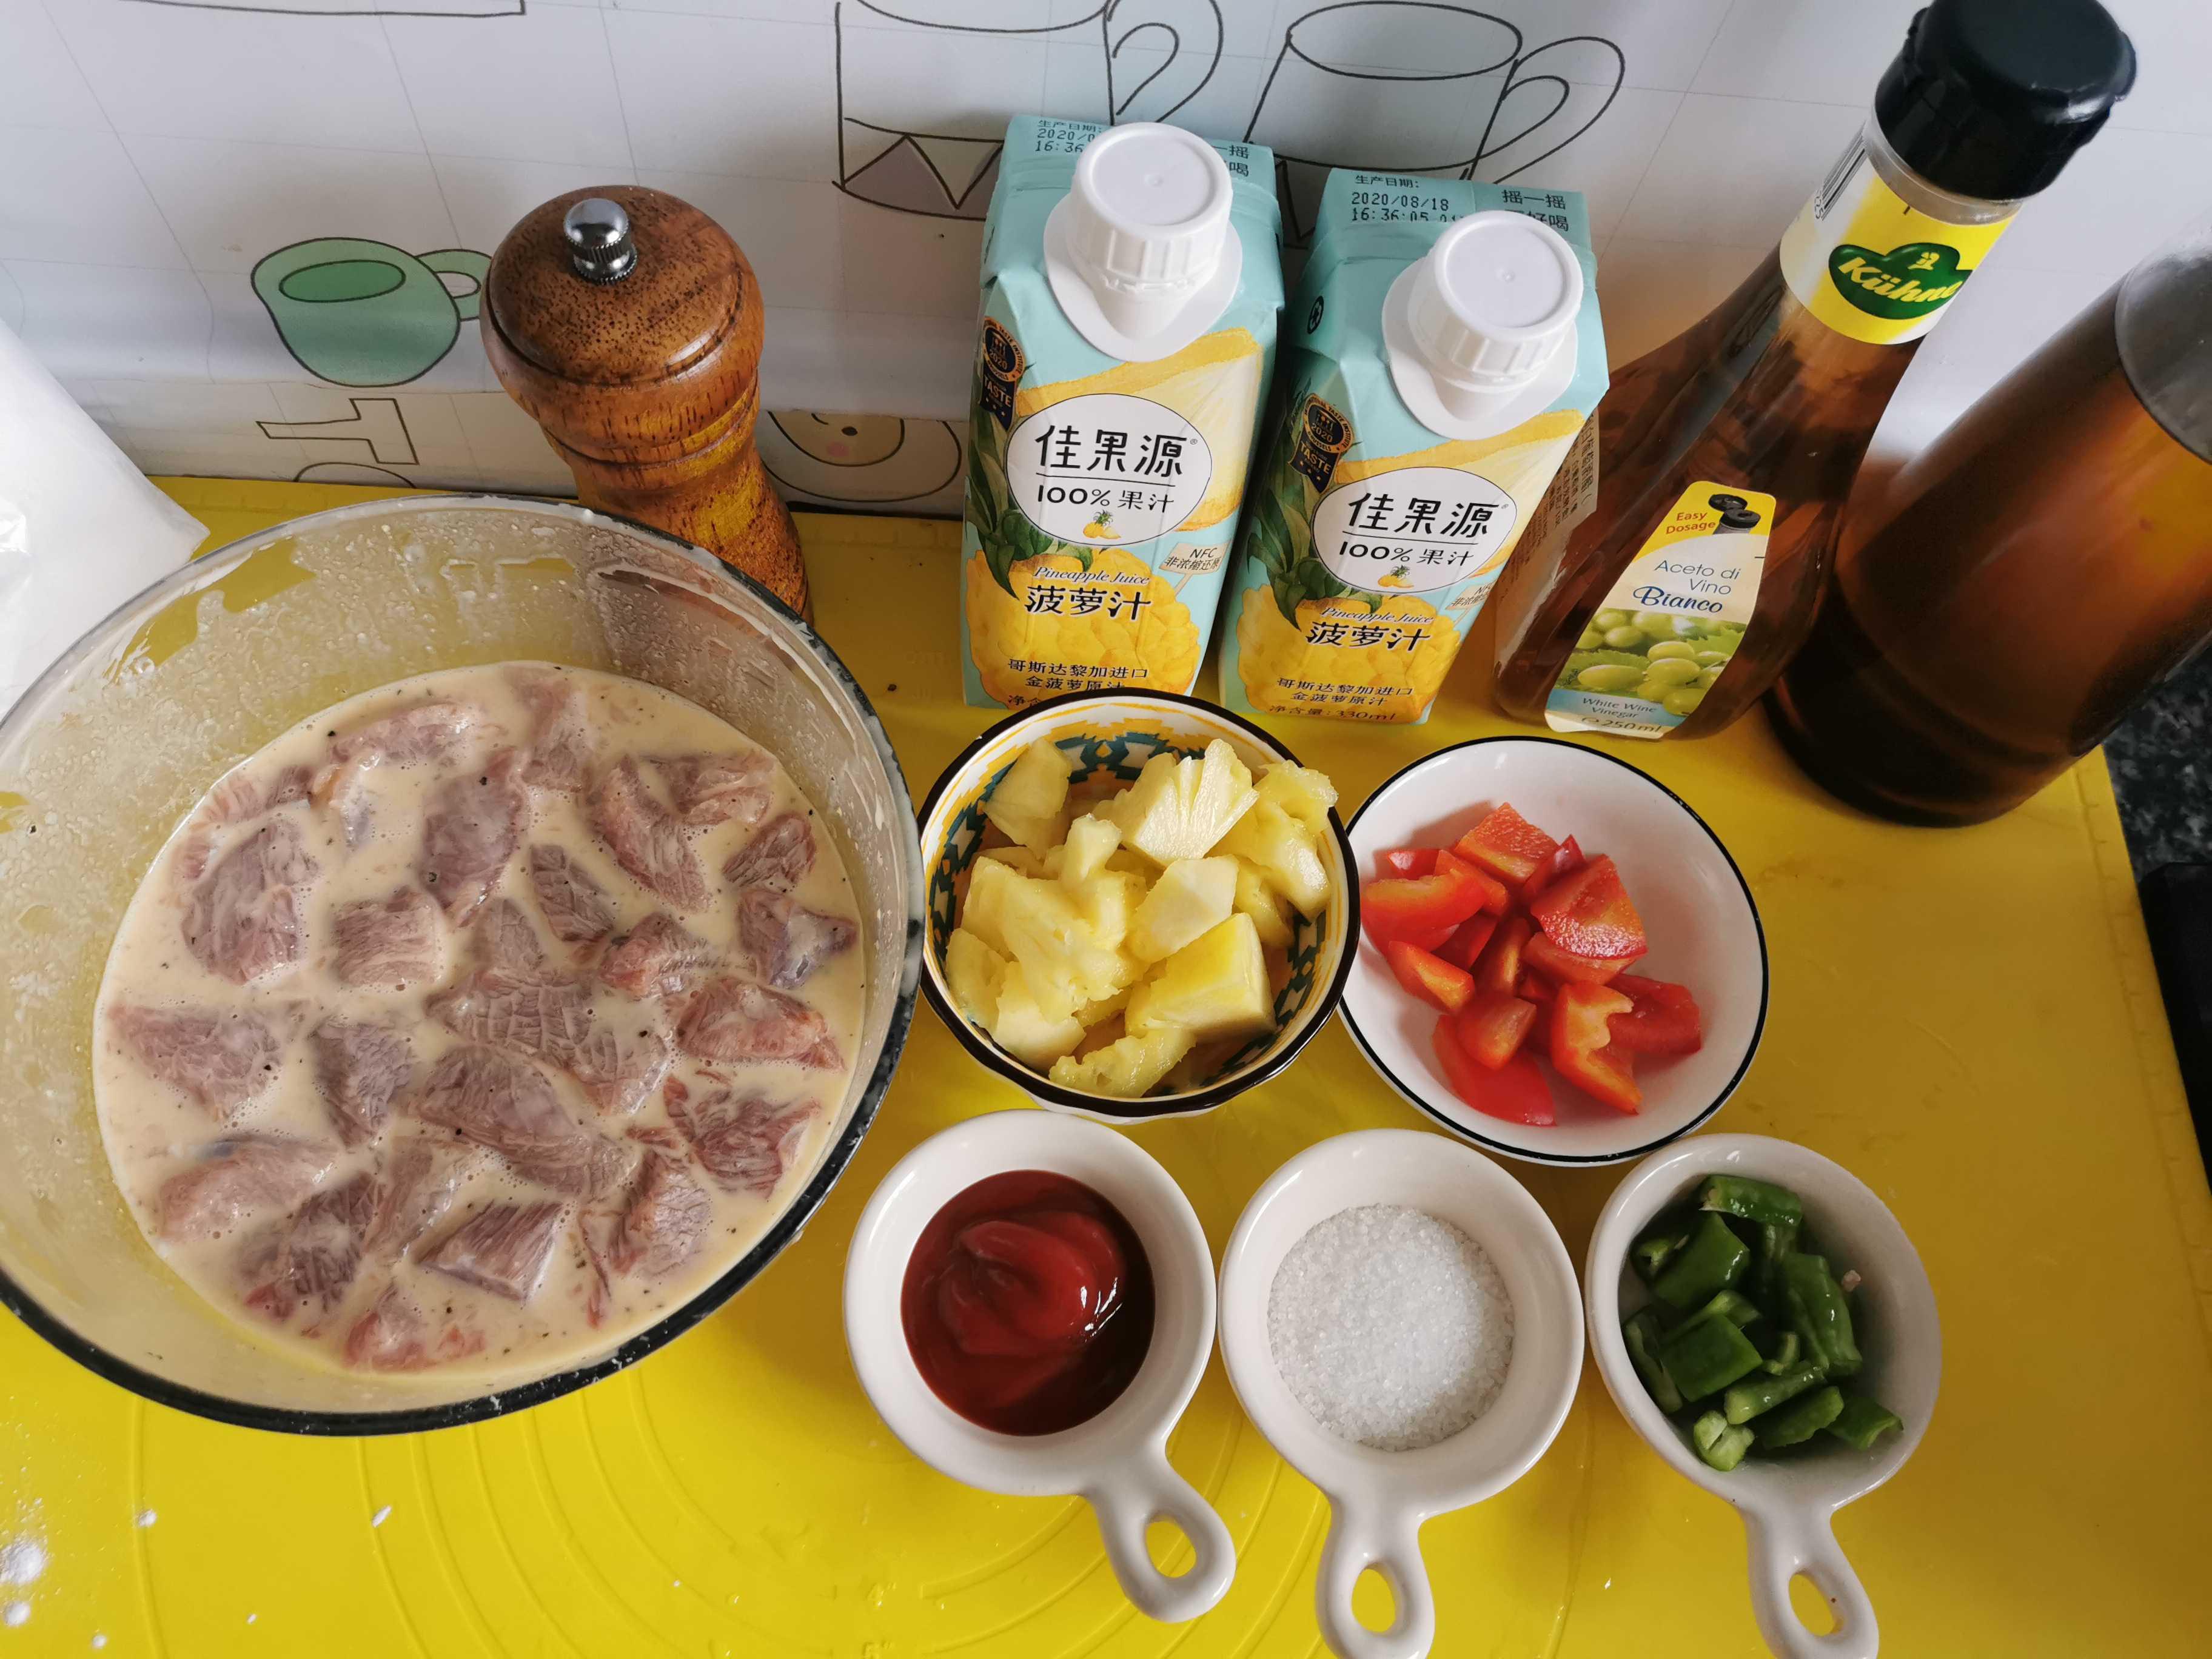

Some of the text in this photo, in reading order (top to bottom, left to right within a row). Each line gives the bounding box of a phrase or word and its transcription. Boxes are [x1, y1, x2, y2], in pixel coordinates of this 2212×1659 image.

[1225, 160, 1249, 176] 喝
[1352, 192, 1449, 211] 2020/08/18
[1501, 189, 1566, 210] 摇一摇
[1838, 256, 1964, 303] Kühne
[984, 376, 1013, 408] TASTE
[1311, 422, 1333, 443] 2020
[1034, 425, 1187, 477] 佳果源
[1300, 440, 1332, 474] TASTE
[1348, 492, 1500, 538] 佳果源
[1676, 512, 1708, 521] Easy
[1666, 521, 1716, 534] Dosage
[1190, 548, 1218, 558] NFC
[1033, 566, 1150, 585] Pineapple Juice
[1654, 560, 1741, 580] Aceto di
[1689, 577, 1732, 595] Vino
[1024, 585, 1151, 621] 菠萝汁
[1632, 586, 1723, 613] Bianco
[1320, 607, 1434, 623] Pineapple Juice
[1305, 622, 1430, 651] 菠萝汁
[1008, 659, 1148, 678] 哥斯达黎加进口
[1277, 677, 1413, 696] 哥斯达黎加进口
[1290, 691, 1388, 706] 金菠萝原汁
[1583, 698, 1658, 713] White Wine
[1592, 707, 1638, 719] Vinegar
